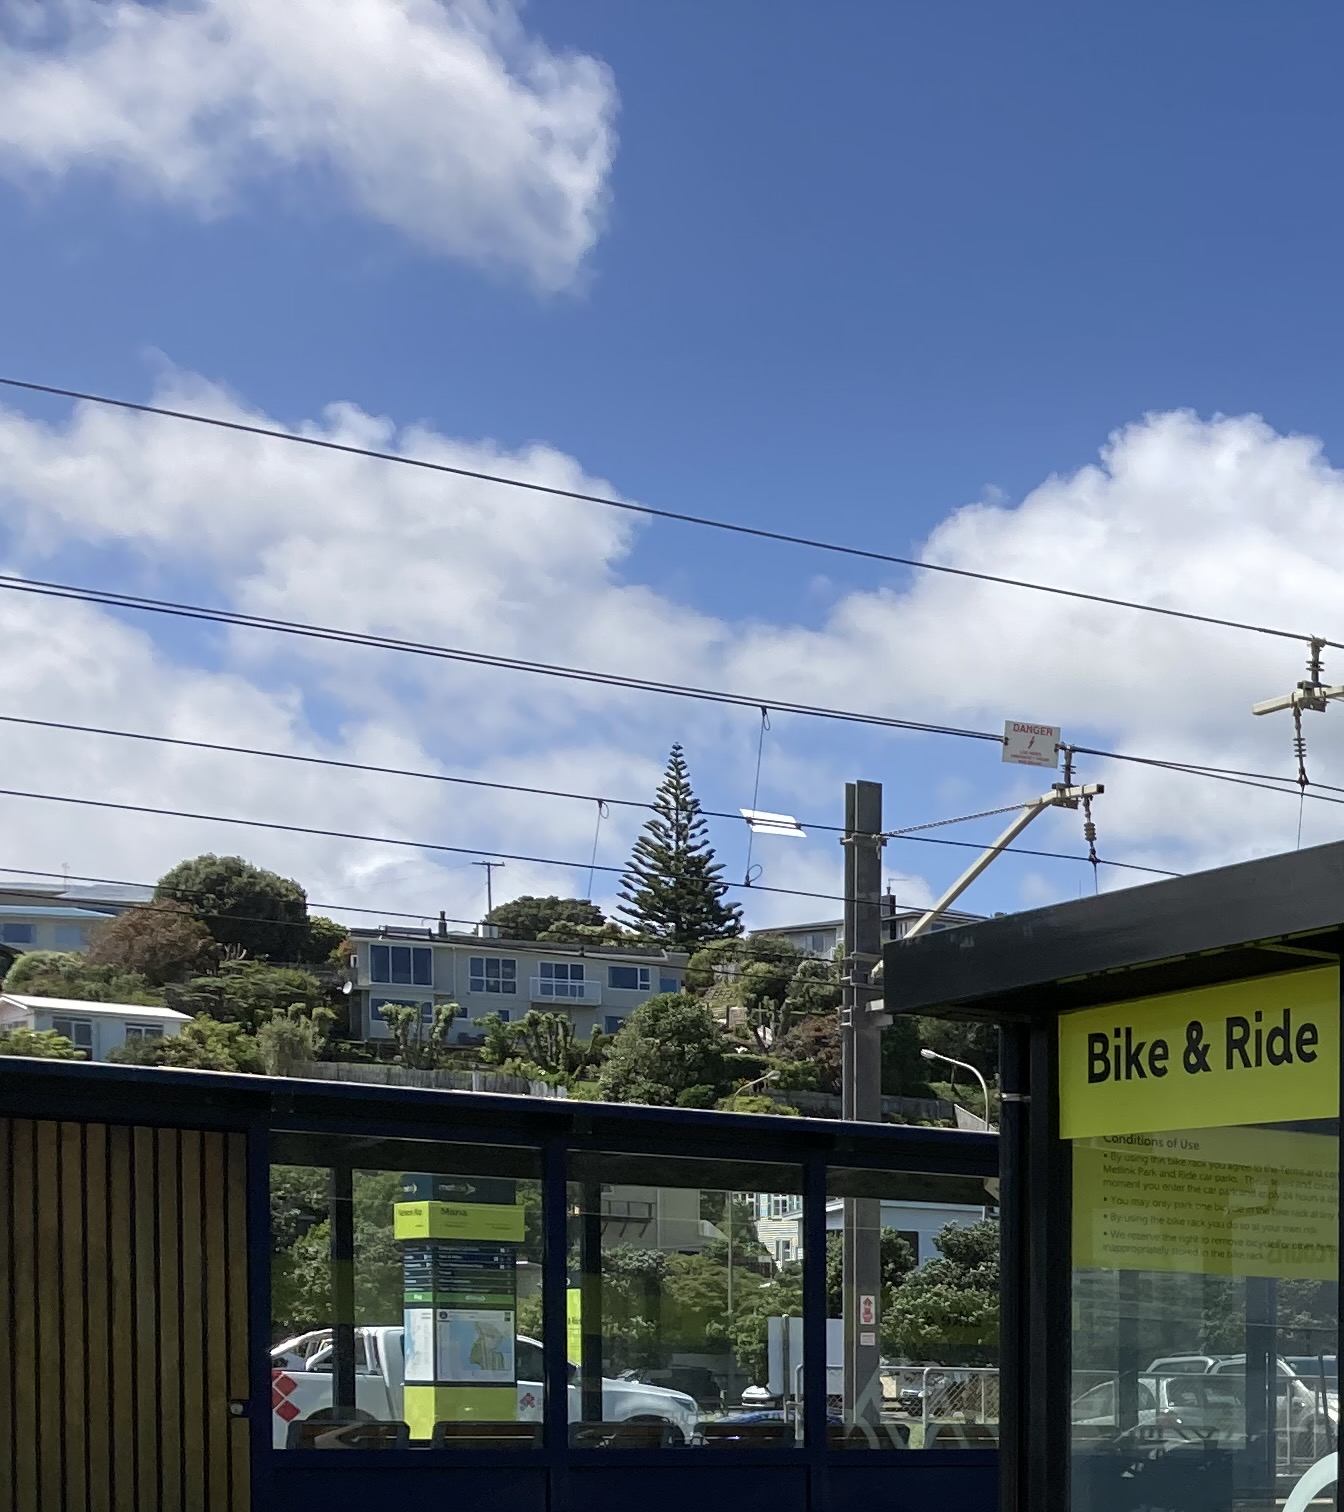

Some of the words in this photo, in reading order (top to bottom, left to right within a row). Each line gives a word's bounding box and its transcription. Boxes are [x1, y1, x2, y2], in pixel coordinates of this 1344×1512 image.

[1013, 723, 1053, 736] DANGER
[1088, 1027, 1169, 1084] Bike
[1183, 1020, 1212, 1075] &
[1225, 1008, 1318, 1070] Ride
[1103, 1134, 1163, 1147] Conditions
[1167, 1136, 1177, 1148] of
[1181, 1139, 1200, 1150] Use
[1103, 1165, 1135, 1175] Metlink
[1138, 1167, 1156, 1176] Park
[1160, 1169, 1176, 1178] and
[1179, 1170, 1197, 1180] Ride
[1142, 1183, 1159, 1191] you
